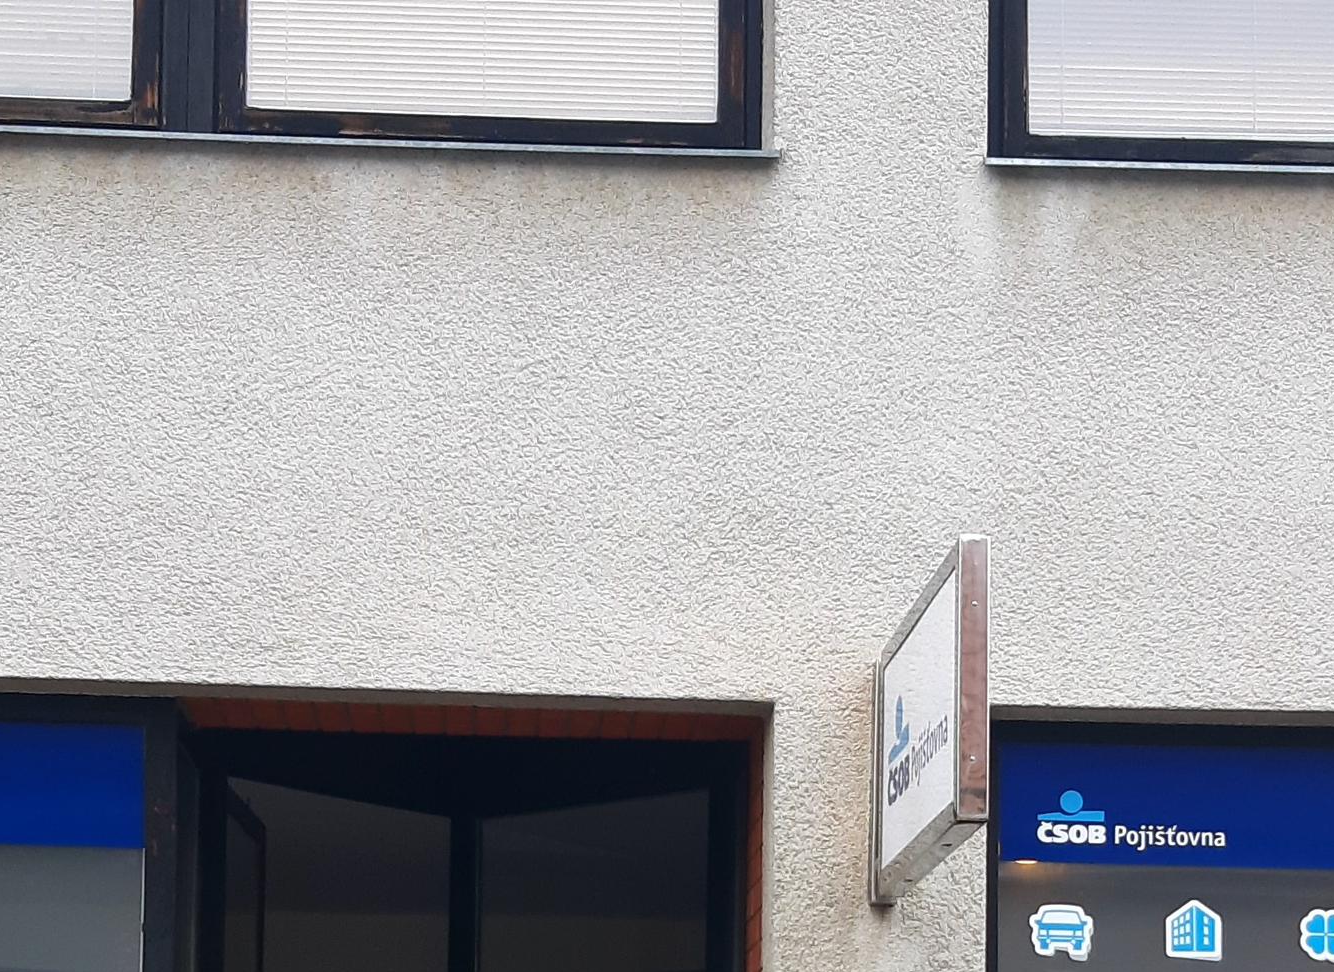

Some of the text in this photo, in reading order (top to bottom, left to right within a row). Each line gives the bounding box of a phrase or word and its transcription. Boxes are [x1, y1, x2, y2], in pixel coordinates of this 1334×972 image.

[888, 715, 948, 806] ČSOB Pojišťovna
[1036, 821, 1226, 851] ČSOB Pojišťovna
